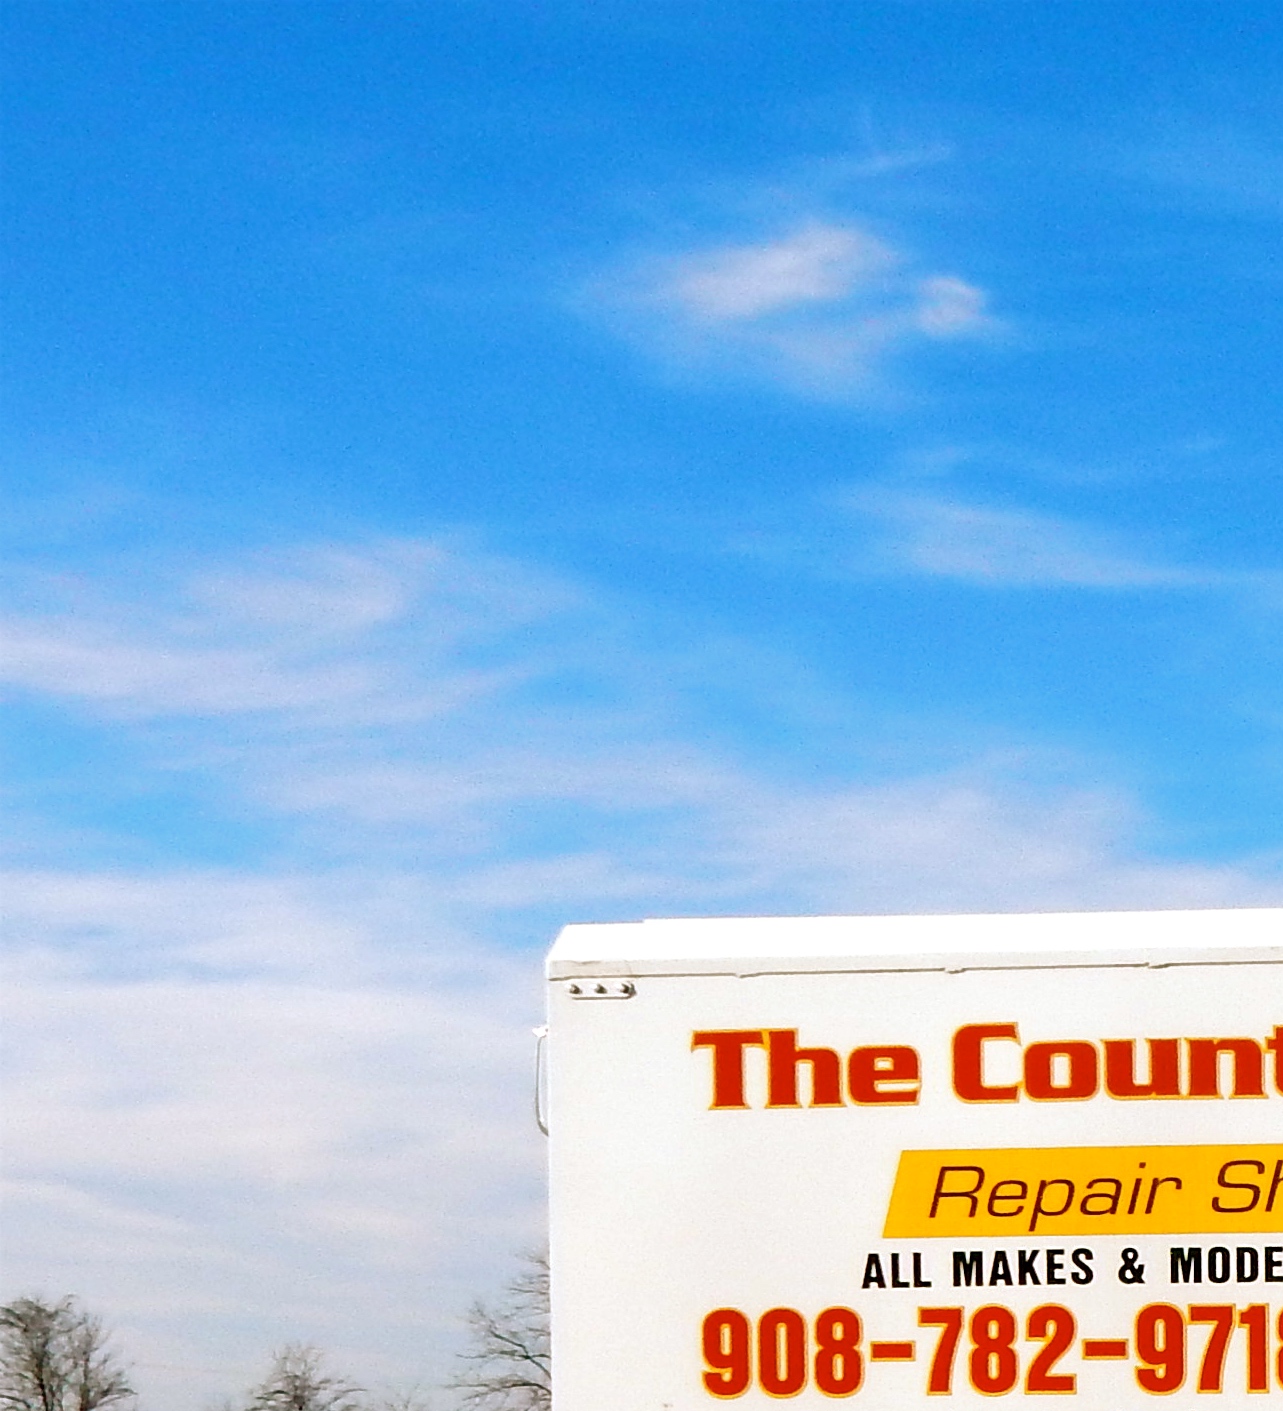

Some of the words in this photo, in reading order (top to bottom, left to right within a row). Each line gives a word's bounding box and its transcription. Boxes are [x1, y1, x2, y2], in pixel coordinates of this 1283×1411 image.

[691, 1028, 921, 1110] The
[930, 1163, 1182, 1231] Repair
[862, 1253, 931, 1289] ALL
[953, 1248, 1093, 1286] MAKES
[1118, 1248, 1145, 1284] &
